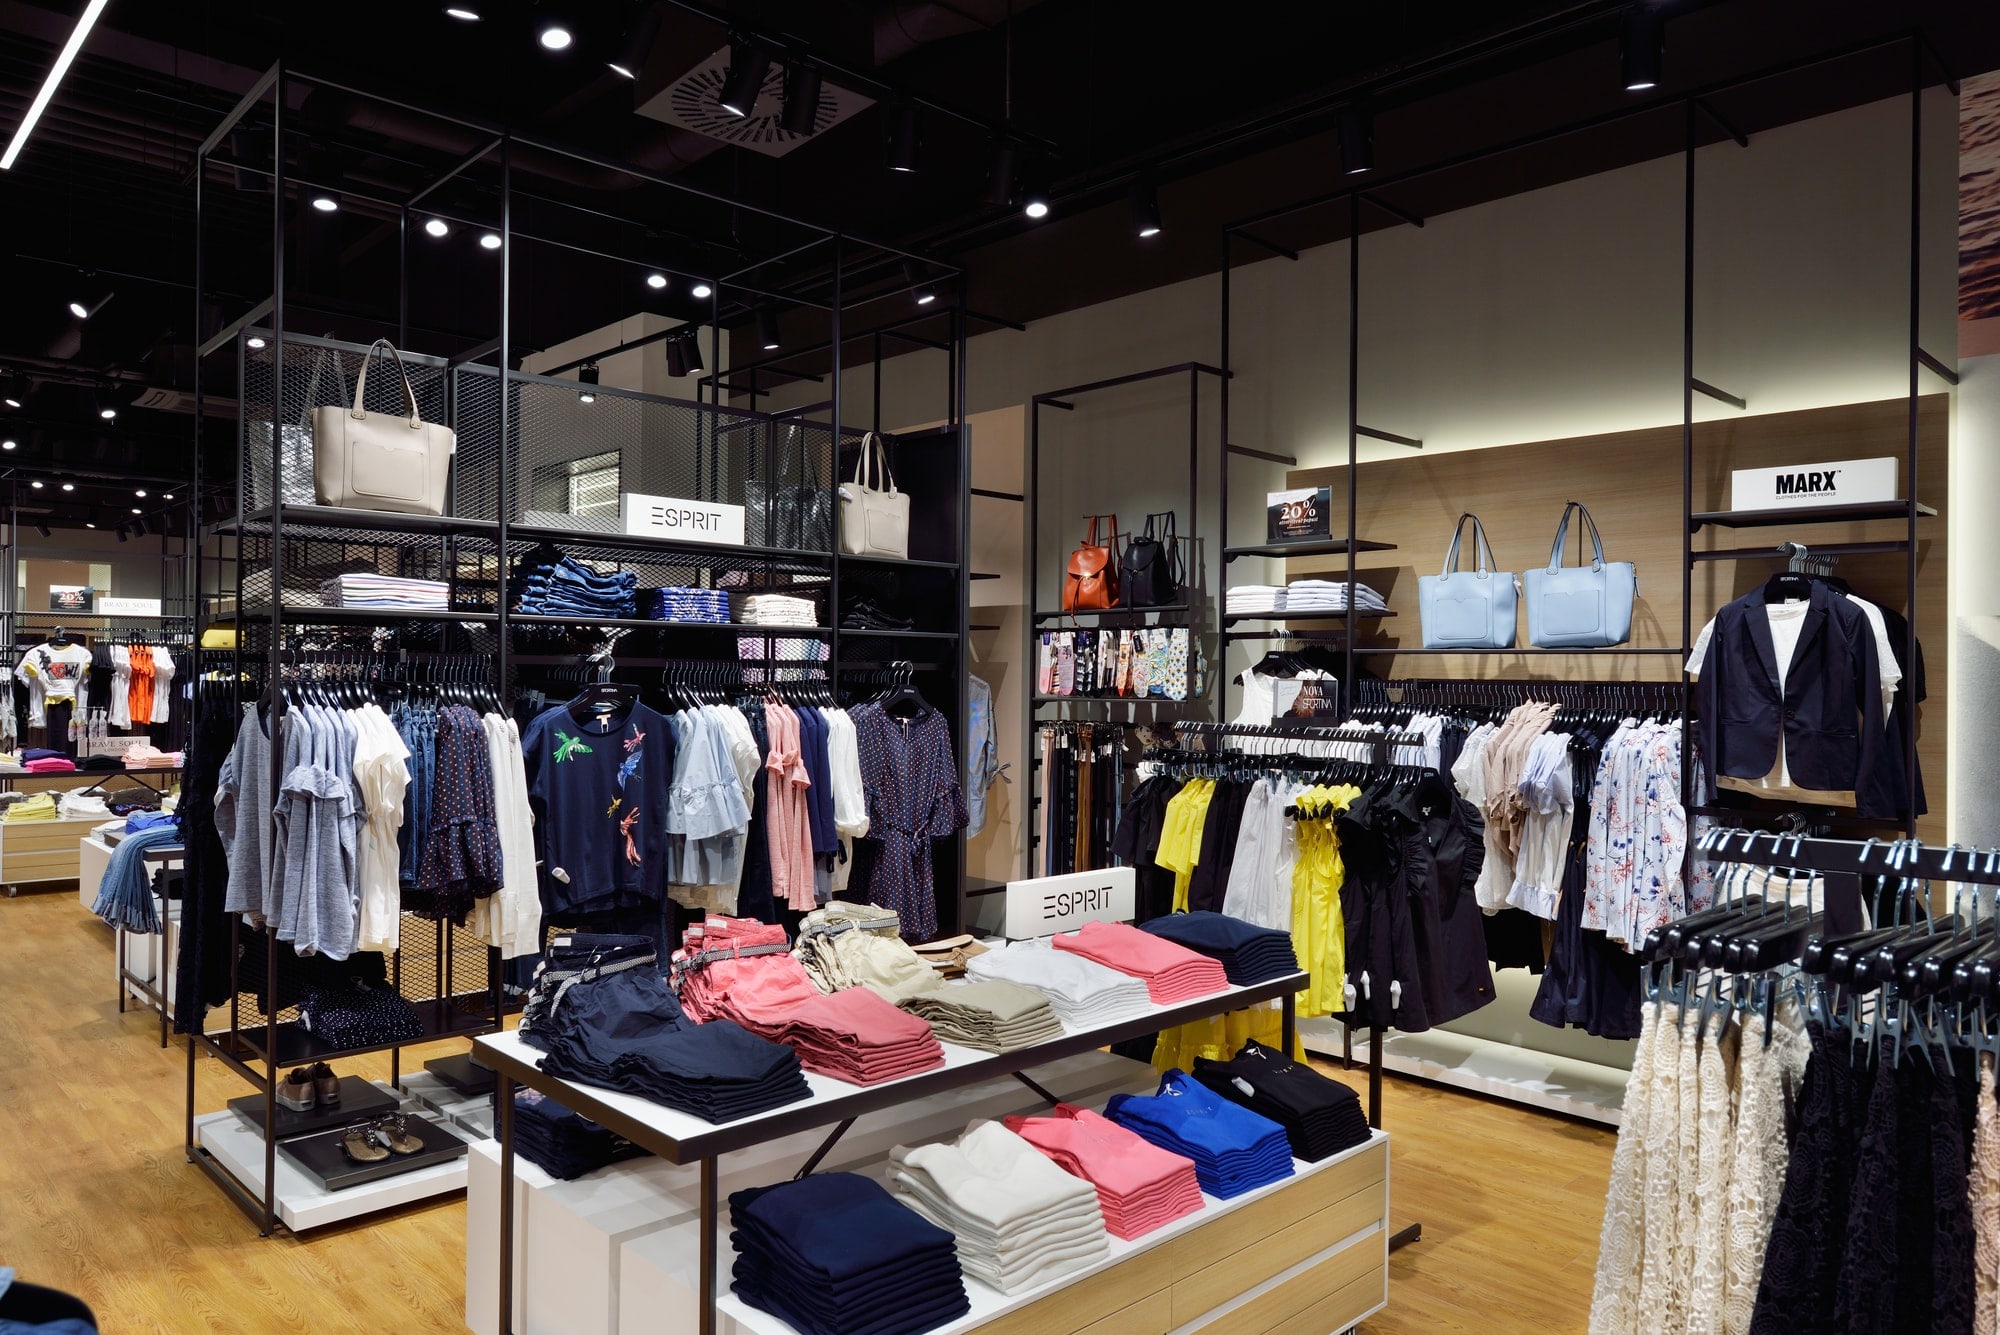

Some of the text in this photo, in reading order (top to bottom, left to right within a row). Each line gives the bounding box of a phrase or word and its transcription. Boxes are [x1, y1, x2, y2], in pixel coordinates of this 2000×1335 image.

[651, 506, 722, 532] ESPRIT
[1281, 498, 1316, 520] 20%
[60, 591, 84, 601] 20%
[1303, 685, 1324, 696] NOVA
[1043, 886, 1113, 919] ESPRIT
